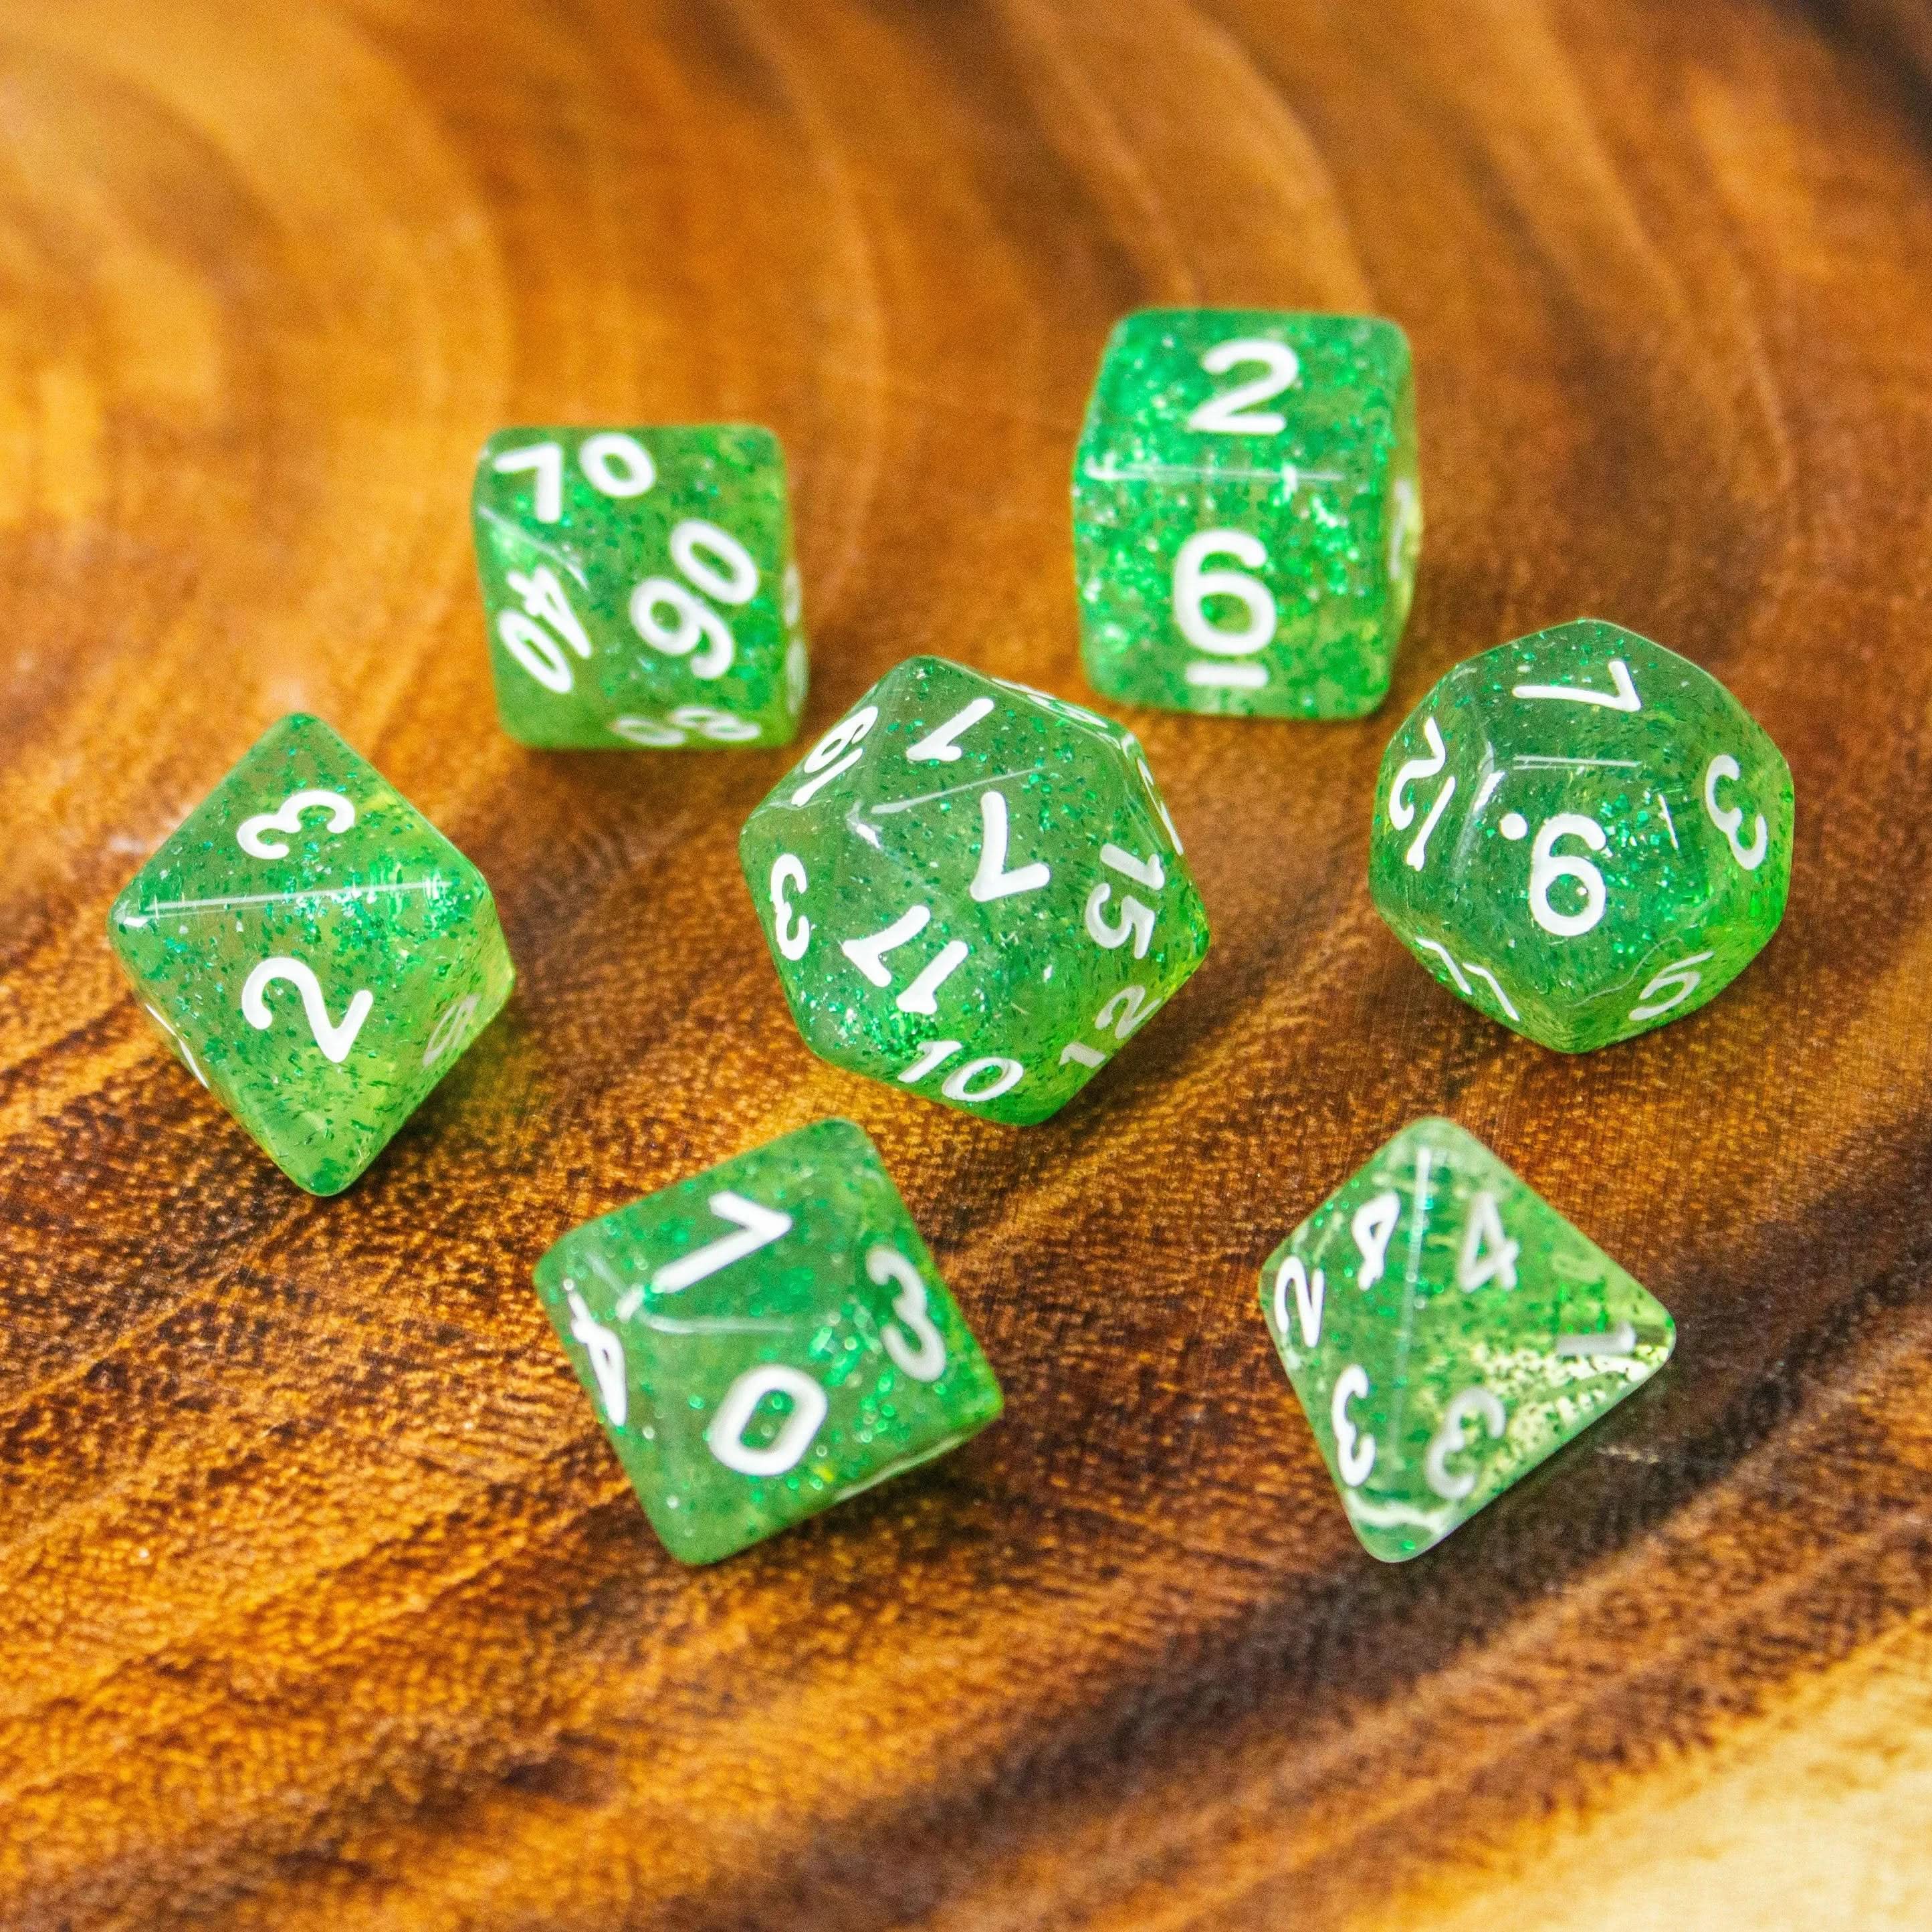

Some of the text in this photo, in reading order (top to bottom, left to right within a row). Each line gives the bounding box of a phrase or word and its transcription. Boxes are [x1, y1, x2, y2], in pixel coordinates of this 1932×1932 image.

[1187, 336, 1299, 435] 2
[494, 433, 655, 524] 70
[630, 519, 759, 679] 90
[1173, 527, 1277, 689] 6
[1511, 659, 1642, 712] 7
[237, 789, 356, 861] 3
[968, 789, 1051, 903] 7
[1705, 754, 1769, 871] 3
[768, 852, 811, 962] 3
[1084, 843, 1166, 960] 15
[241, 955, 374, 1064] 2
[841, 904, 969, 1016] 17
[1628, 951, 1715, 1022] 5
[897, 1040, 1025, 1103] 10
[1457, 1192, 1520, 1293] 4
[866, 1245, 947, 1384] 3
[1274, 1255, 1325, 1349] 2
[706, 1362, 829, 1477] 0
[1330, 1364, 1378, 1488] 3
[1424, 1387, 1506, 1501] 3
